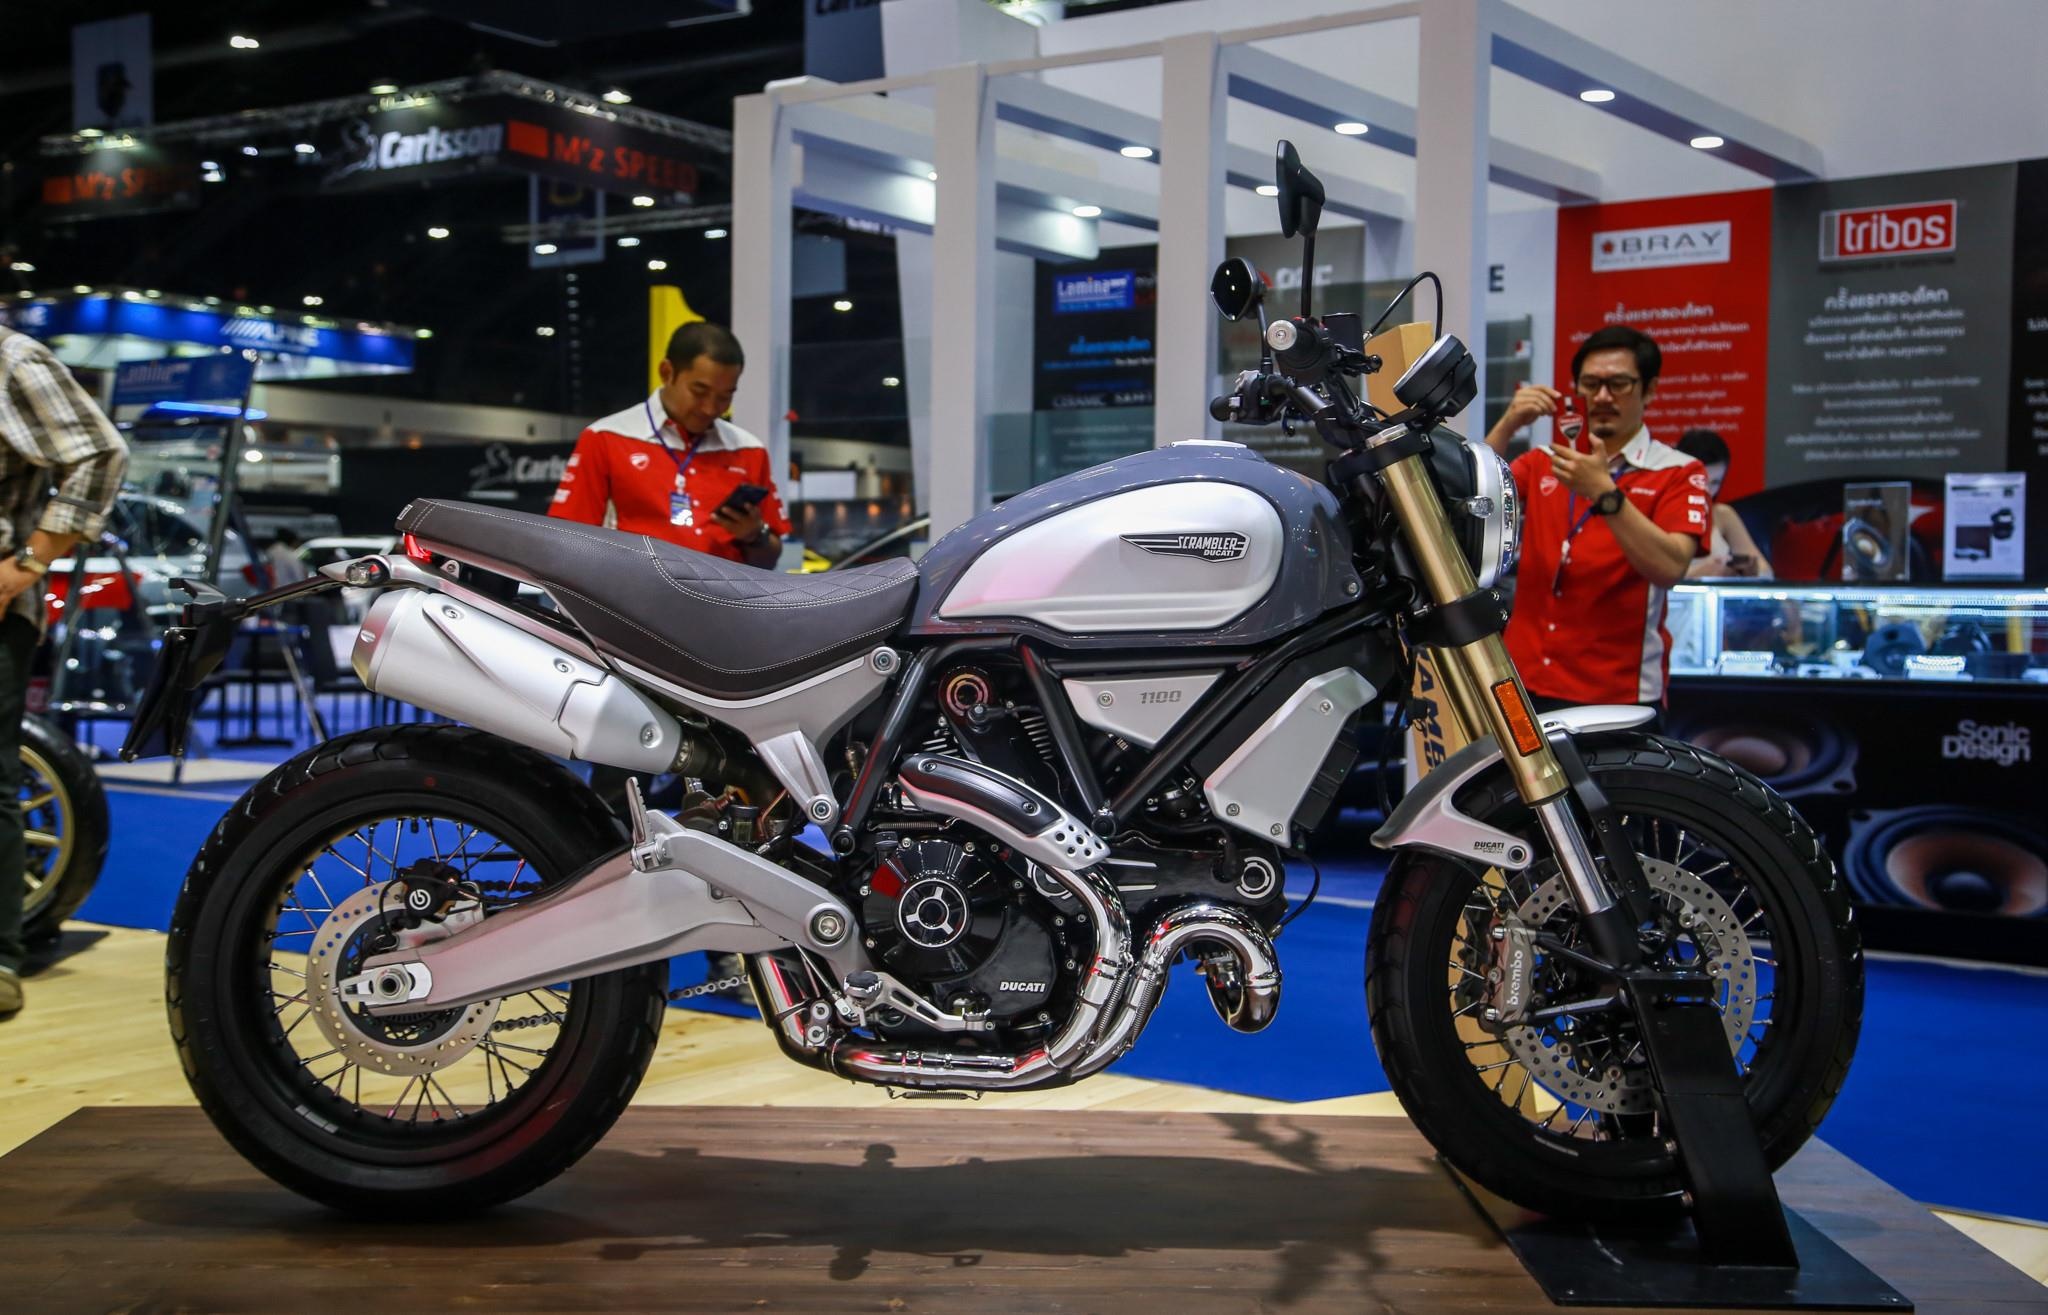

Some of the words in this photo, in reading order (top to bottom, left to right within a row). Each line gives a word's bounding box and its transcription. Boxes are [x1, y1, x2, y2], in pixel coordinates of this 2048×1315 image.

[378, 123, 501, 169] Carlsson
[614, 146, 697, 193] SPEED
[1620, 229, 1723, 254] BRAY
[1844, 212, 1946, 252] tribos
[1178, 536, 1238, 550] SCRAMBLER
[1203, 549, 1234, 557] DUCATI
[1140, 690, 1182, 705] 1100
[1958, 719, 2031, 744] Sonic
[1942, 735, 2031, 767] Design
[1474, 840, 1505, 849] DUCATI
[999, 981, 1046, 993] DUCATI
[1506, 949, 1524, 1006] brembo
